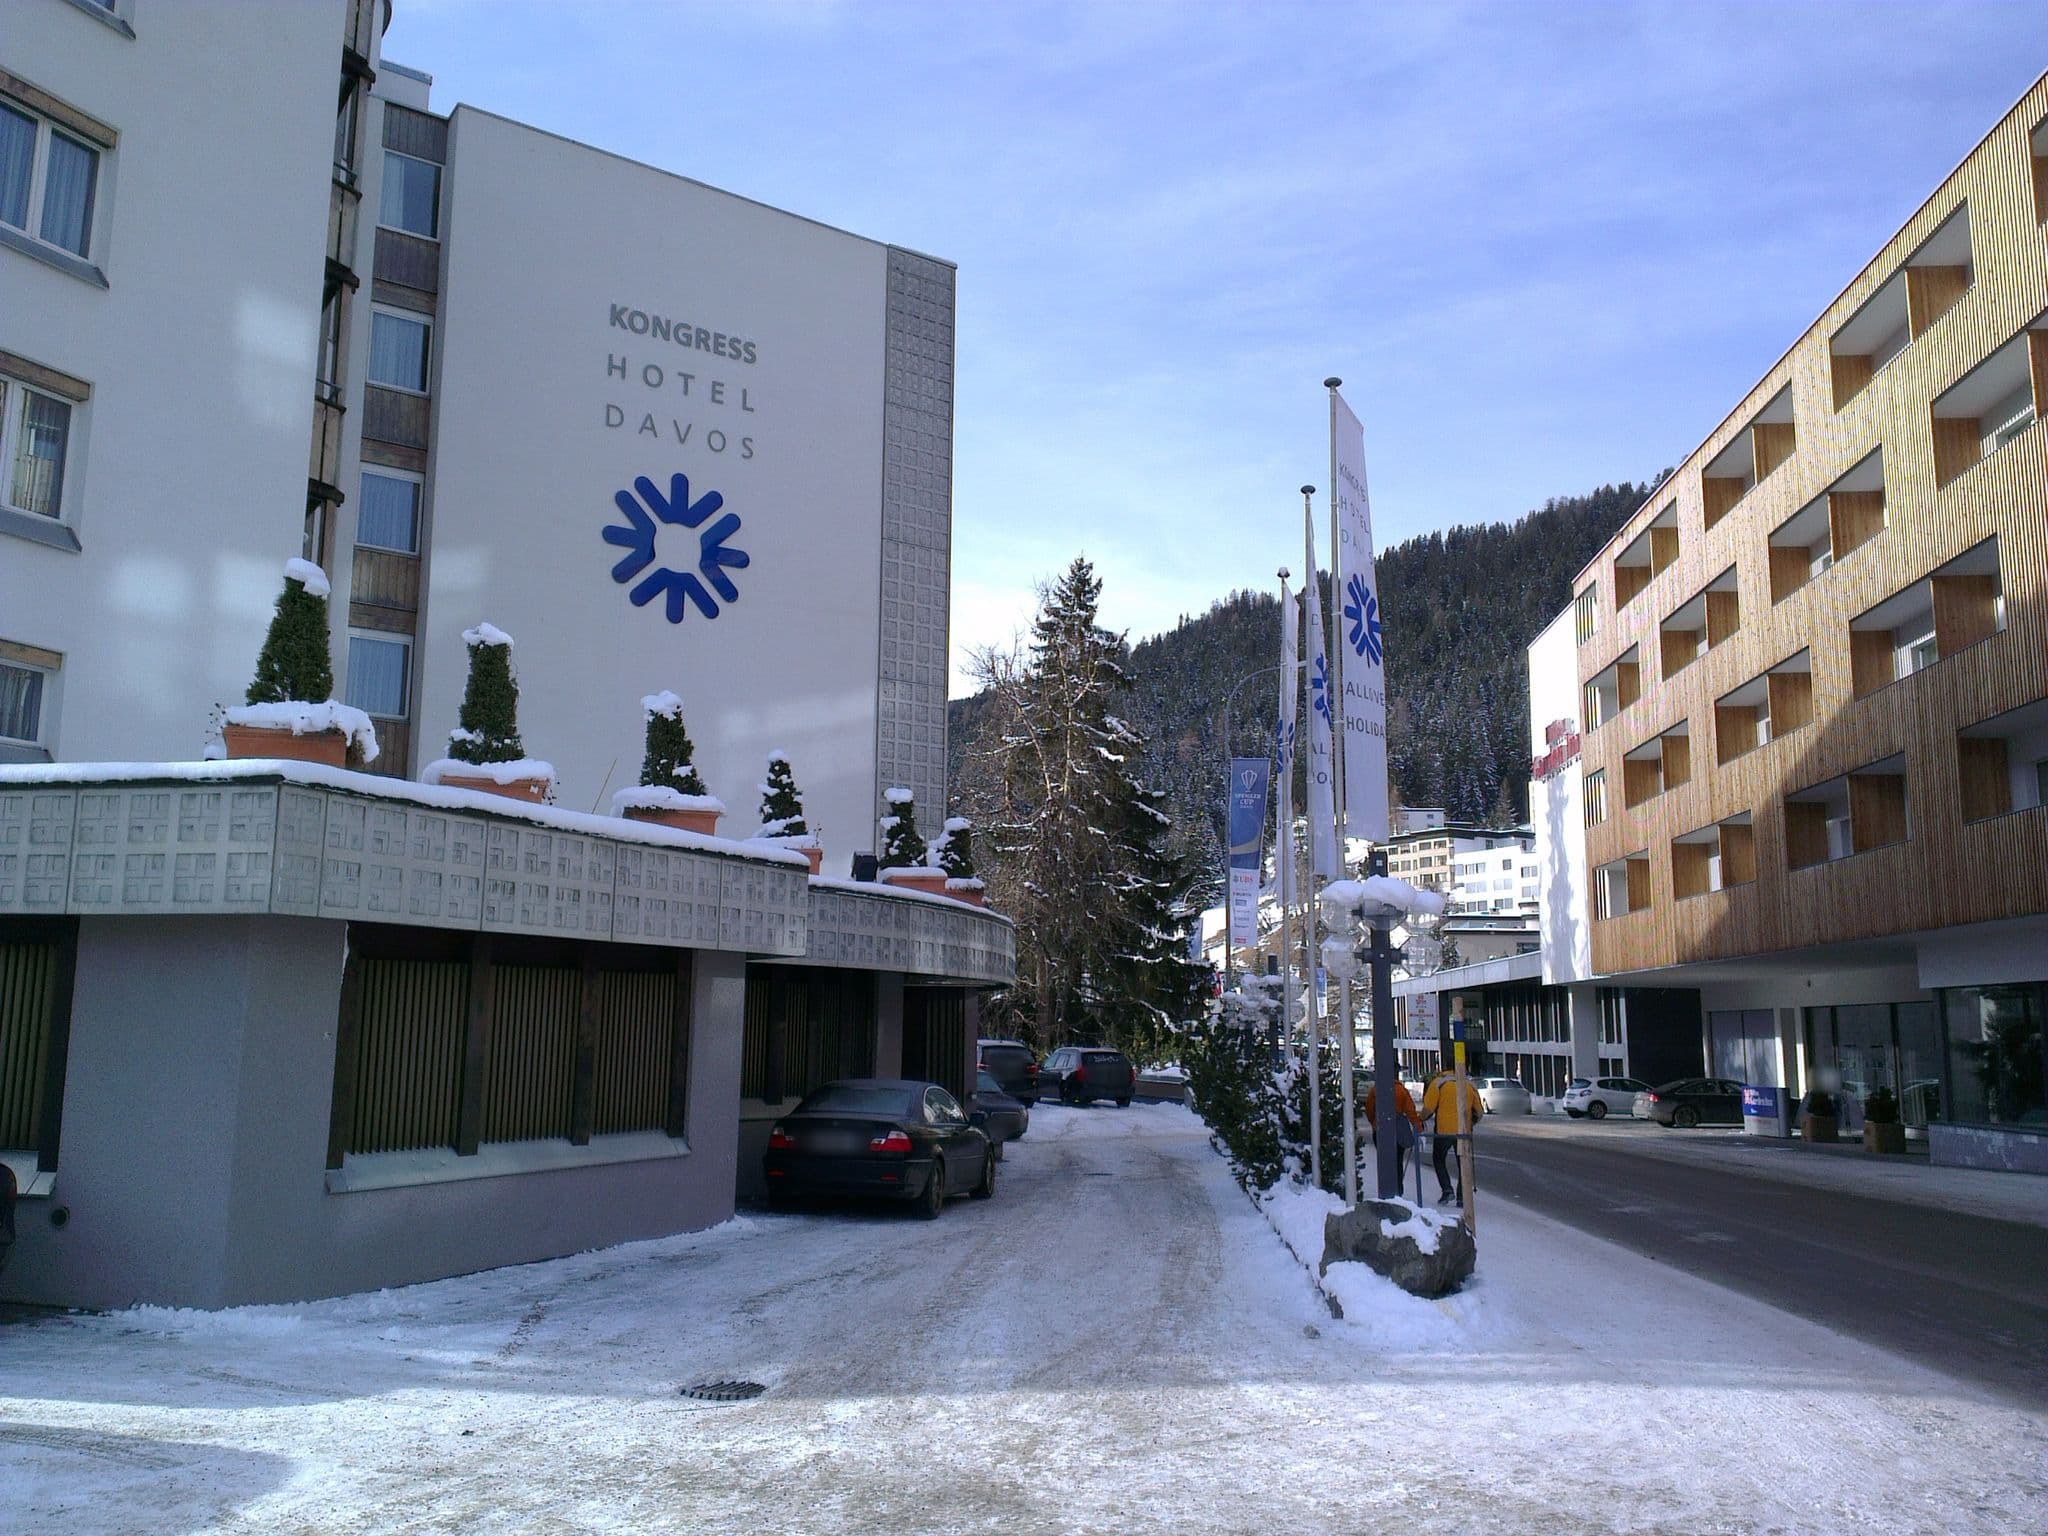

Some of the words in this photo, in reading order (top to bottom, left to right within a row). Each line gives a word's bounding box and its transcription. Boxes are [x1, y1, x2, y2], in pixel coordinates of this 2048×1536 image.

[609, 303, 757, 364] KONGRESS
[607, 353, 755, 413] HOTEL
[605, 403, 754, 459] DAVOS
[1341, 529, 1374, 566] DAS
